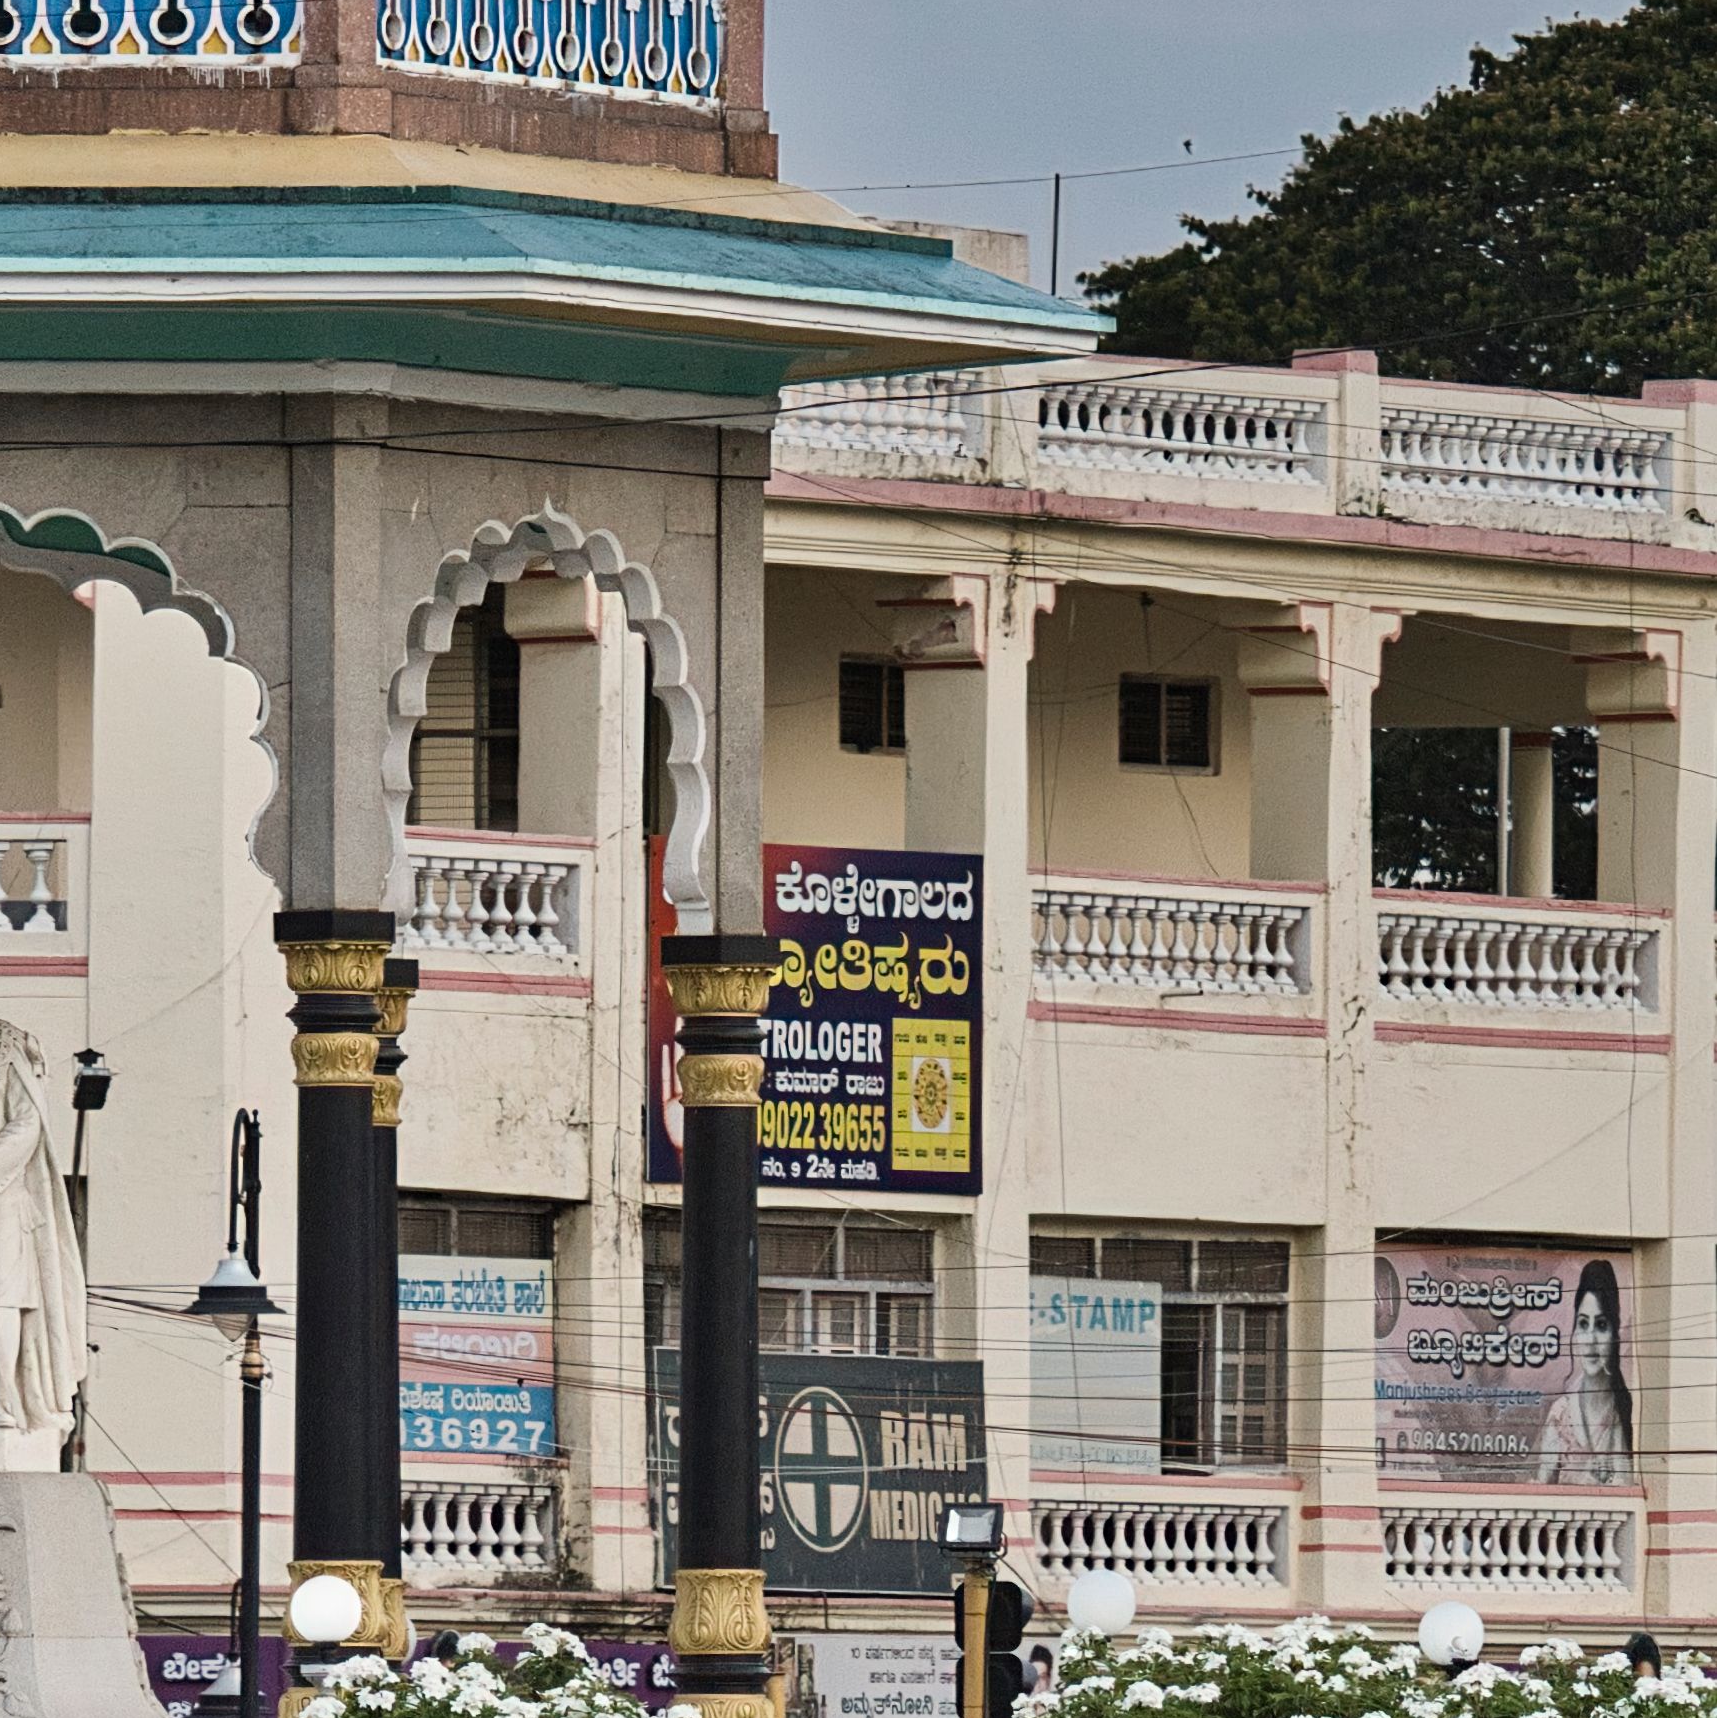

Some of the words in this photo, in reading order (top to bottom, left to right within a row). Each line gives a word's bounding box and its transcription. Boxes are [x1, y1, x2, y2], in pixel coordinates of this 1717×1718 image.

[775, 860, 974, 934] ಕೊಳ್ಳೇಗಾಲದ
[757, 1019, 883, 1063] TROLOGER
[775, 1066, 839, 1095] ಕುಮಾರ್
[845, 1074, 885, 1097] ರಾಜು
[757, 1100, 816, 1150] 9022
[819, 1103, 886, 1152] 39655
[806, 1154, 836, 1180] 2ನೇ
[1407, 1270, 1562, 1317] ಮಂಜುಶ್ರೀಸ್
[1408, 1325, 1561, 1378] ಬ್ಯೂಟಿಕೇರ್
[451, 1387, 531, 1414] ರಿಯಾಯಿತಿ
[880, 1410, 967, 1471] RAM
[869, 1489, 981, 1542] MEDIC
